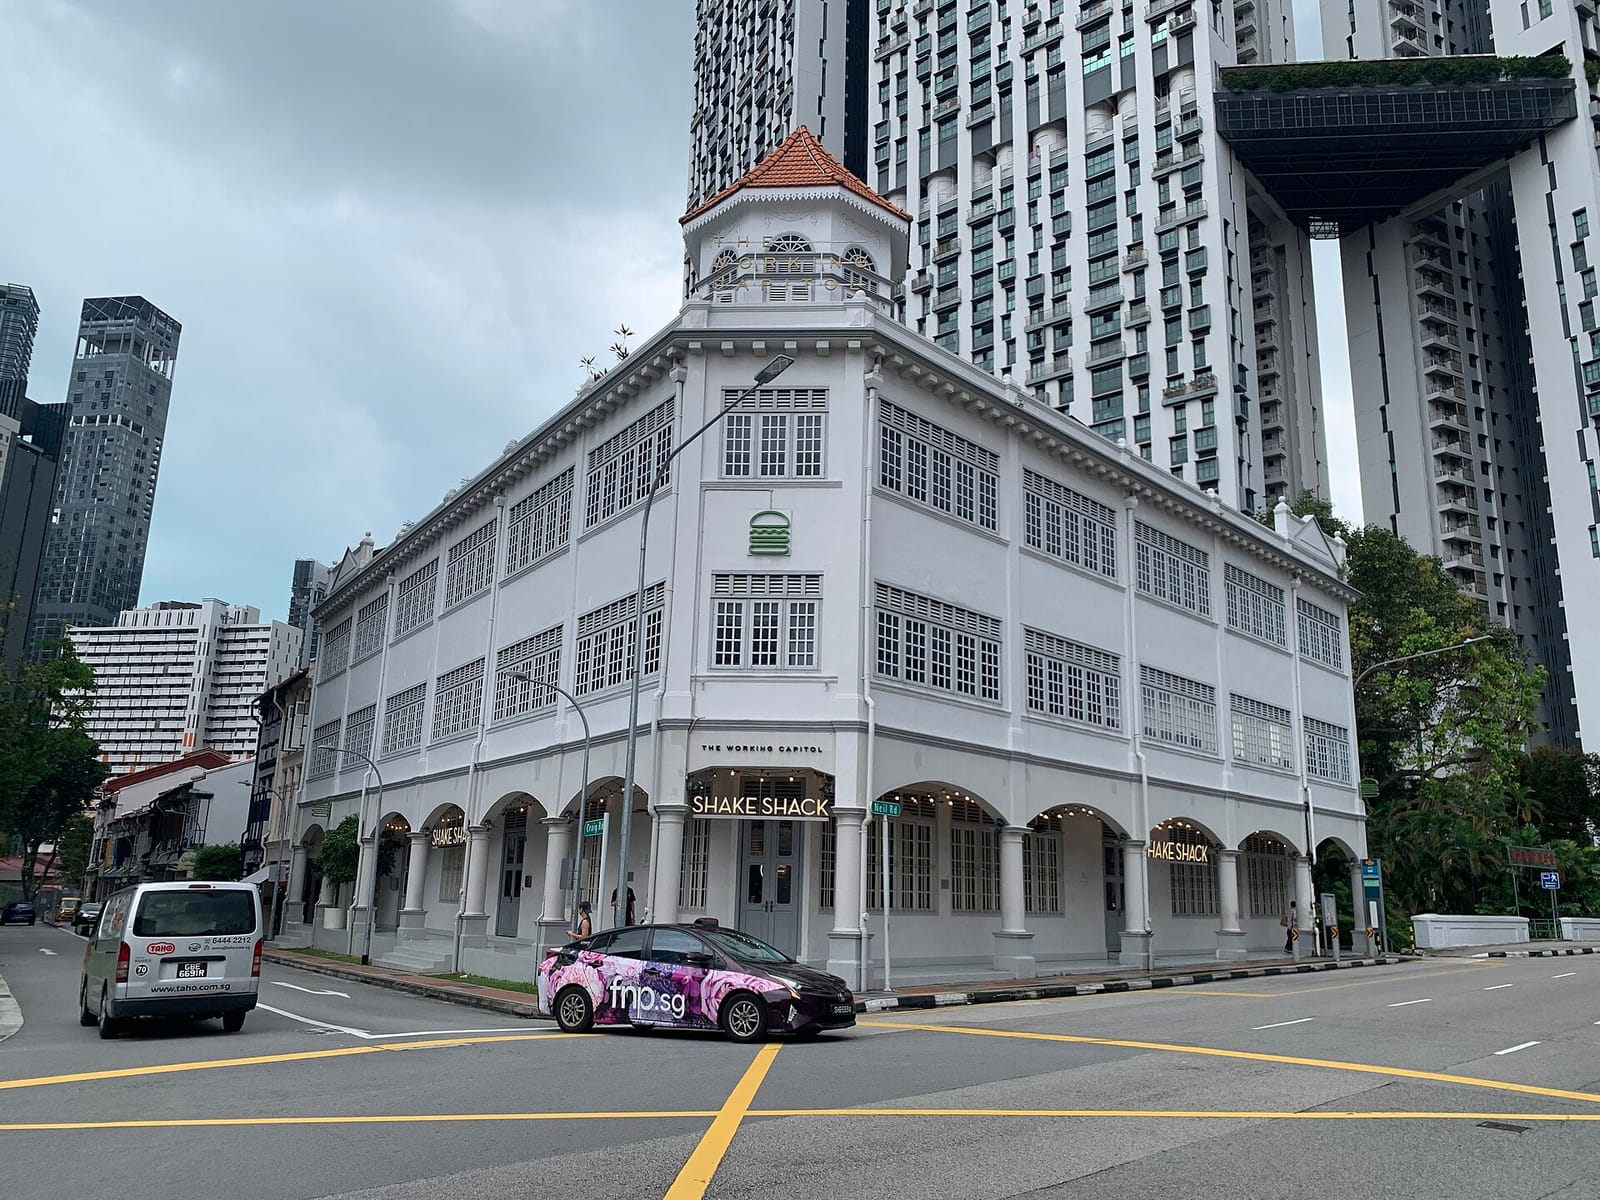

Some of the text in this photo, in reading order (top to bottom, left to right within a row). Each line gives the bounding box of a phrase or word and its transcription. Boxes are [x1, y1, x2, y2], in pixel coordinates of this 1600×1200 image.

[714, 235, 773, 248] THE
[713, 256, 869, 269] WORKING
[712, 278, 861, 291] CAPITOL
[702, 744, 721, 752] THE
[778, 745, 823, 753] CAPITOL
[692, 795, 829, 816] SHAKE SHACK
[874, 802, 898, 815] Neil Rd
[586, 822, 598, 834] Craig
[431, 826, 467, 846] SHAKE SHA
[1147, 840, 1209, 862] HAKE SHACK
[232, 936, 251, 944] 2212
[150, 945, 173, 953] TAHO
[179, 969, 205, 978] 6691R
[184, 963, 201, 971] GBE
[150, 983, 231, 993] www.taho.com.sg
[610, 975, 685, 1019] fnp.sg
